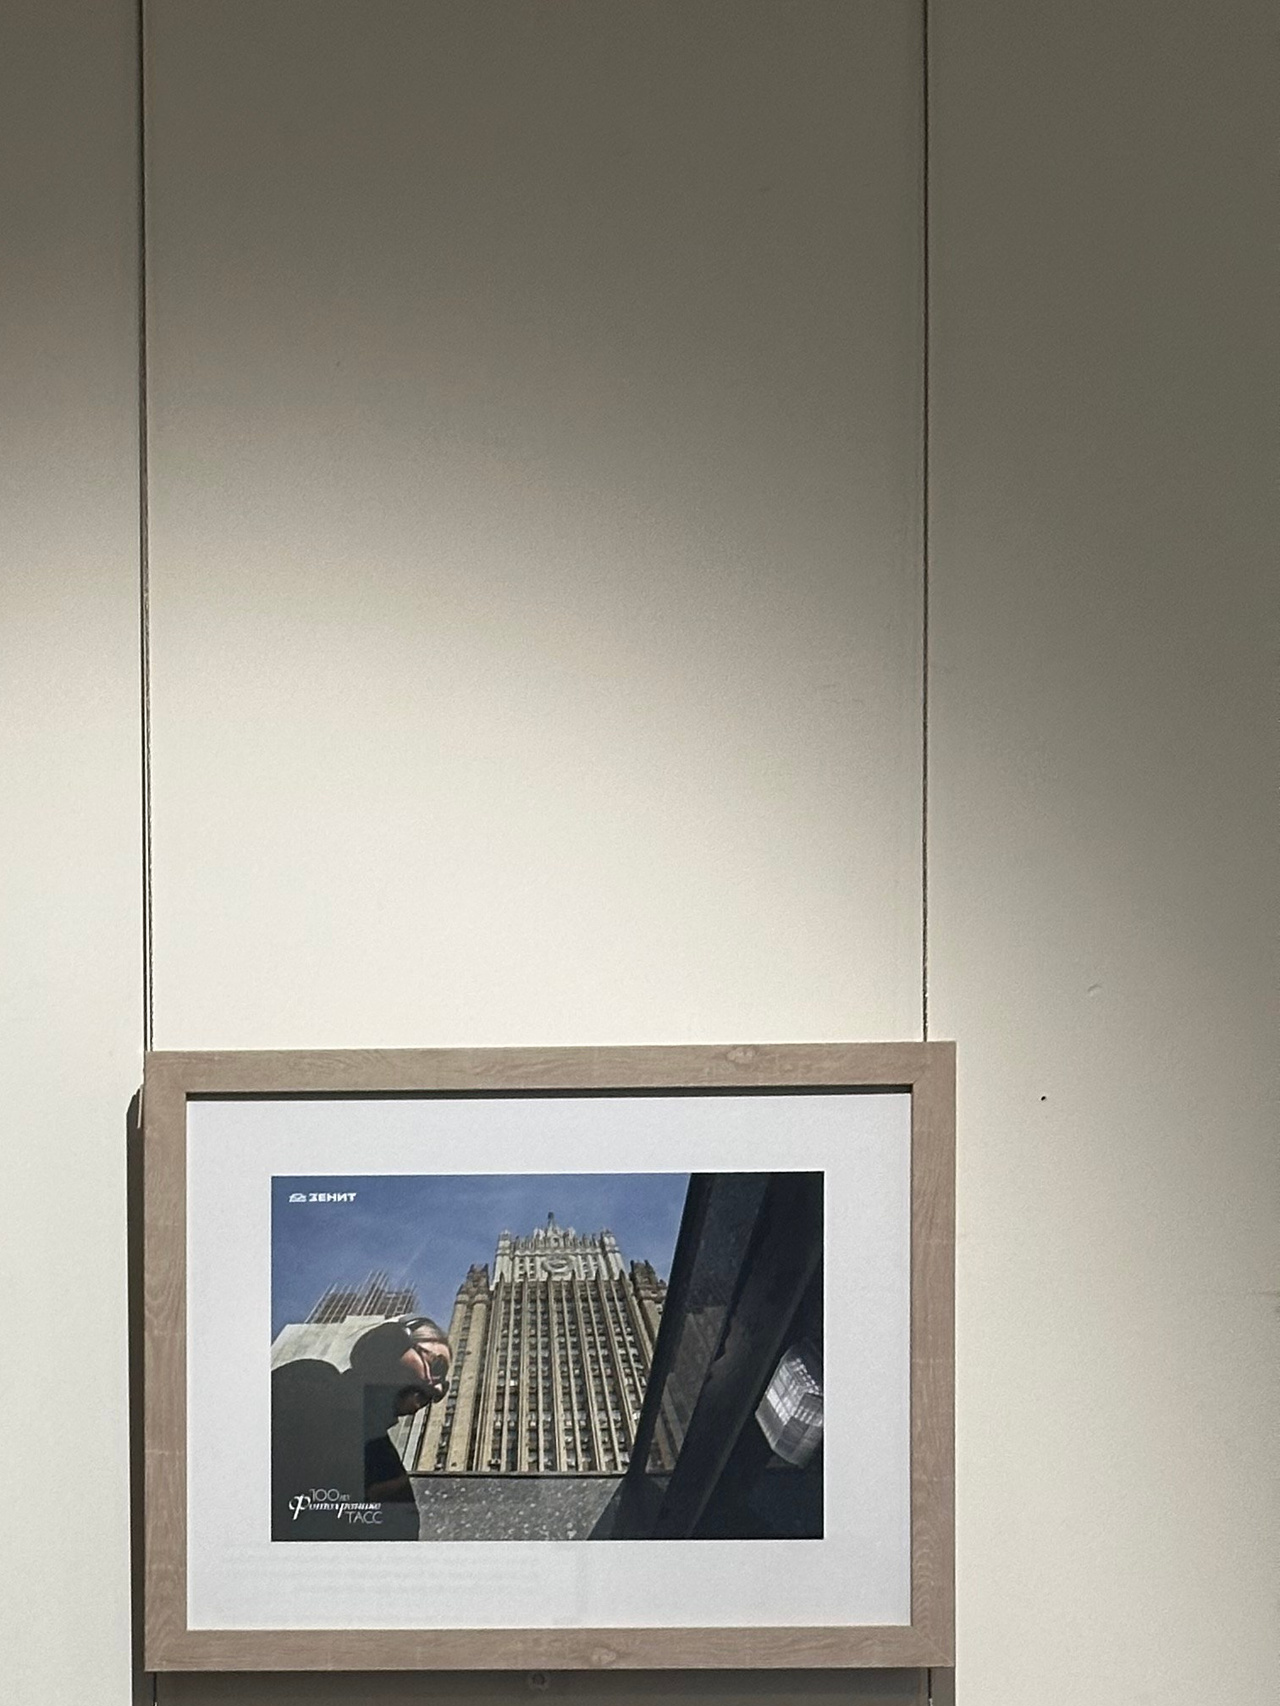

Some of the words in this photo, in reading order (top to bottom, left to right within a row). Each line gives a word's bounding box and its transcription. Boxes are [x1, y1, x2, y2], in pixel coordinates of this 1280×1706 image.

[308, 1192, 357, 1202] ЗЕНИТ
[310, 1488, 340, 1502] 100
[345, 1511, 383, 1524] ТАСС
